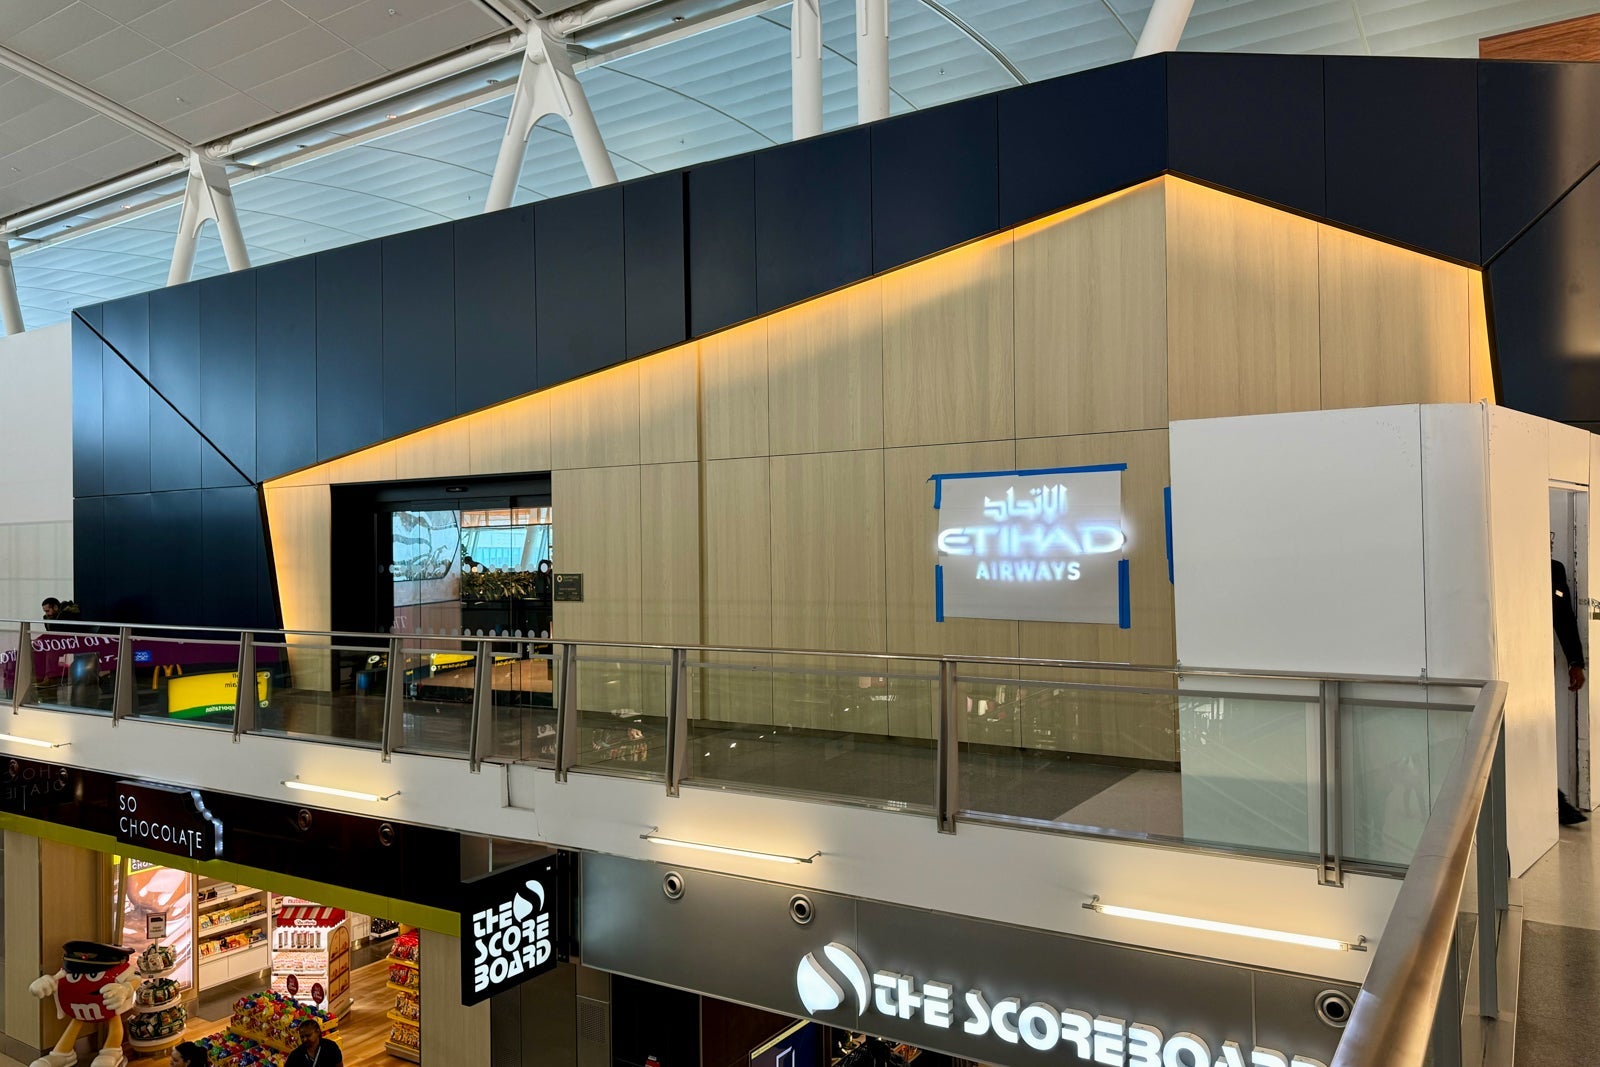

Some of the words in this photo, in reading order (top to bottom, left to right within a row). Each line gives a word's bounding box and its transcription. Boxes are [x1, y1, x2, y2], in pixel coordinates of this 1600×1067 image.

[938, 522, 1126, 556] ETIHAD
[976, 561, 1081, 581] AIRWAYS
[120, 794, 137, 813] SO
[119, 816, 202, 857] CHOCOLATE
[473, 901, 513, 938] THE
[475, 912, 550, 966] SCORE
[475, 939, 552, 993] BOARD
[71, 1002, 105, 1021] m
[873, 970, 954, 1029] THE
